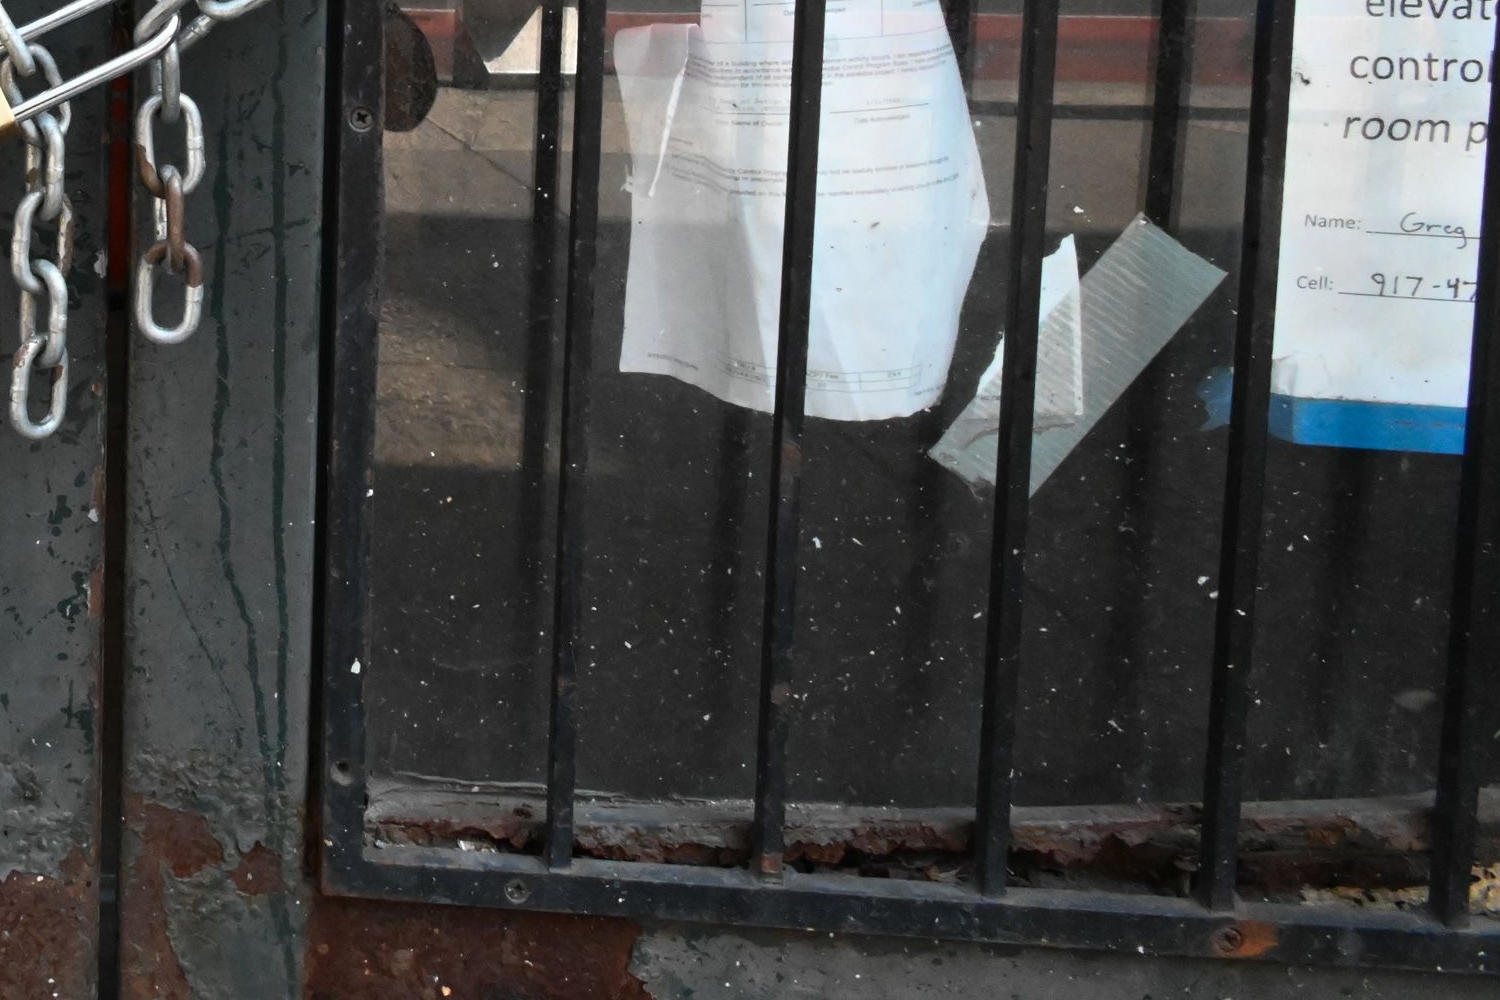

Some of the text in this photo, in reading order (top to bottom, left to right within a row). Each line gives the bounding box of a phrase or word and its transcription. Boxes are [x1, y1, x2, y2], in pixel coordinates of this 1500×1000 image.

[1343, 117, 1450, 143] room
[1304, 212, 1467, 249] Name: Greg
[1296, 276, 1334, 291] Cell:
